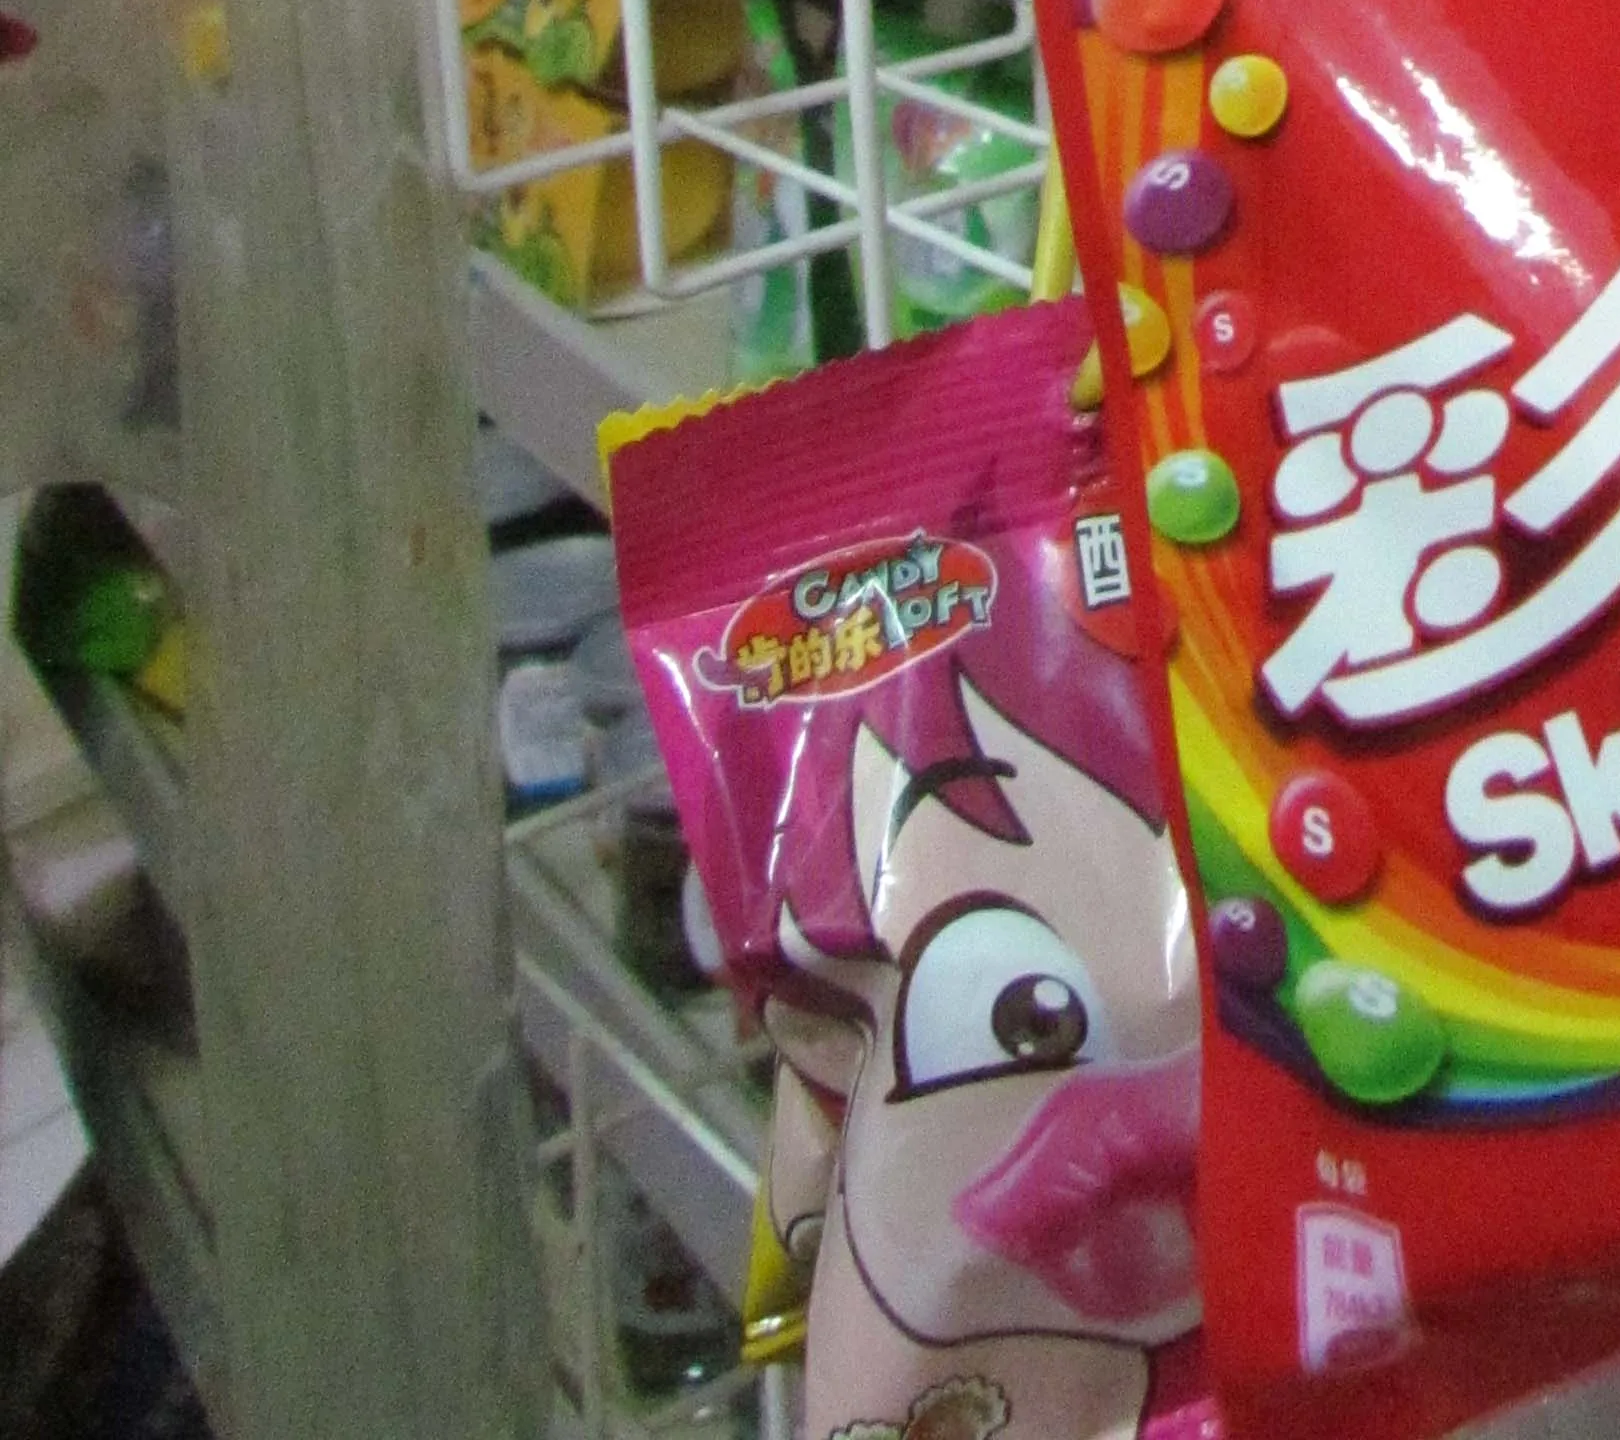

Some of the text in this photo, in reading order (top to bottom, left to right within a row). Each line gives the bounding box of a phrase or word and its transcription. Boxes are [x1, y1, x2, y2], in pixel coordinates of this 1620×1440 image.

[794, 536, 945, 621] CANDY
[736, 604, 885, 700] 肯的乐
[1302, 808, 1336, 856] S
